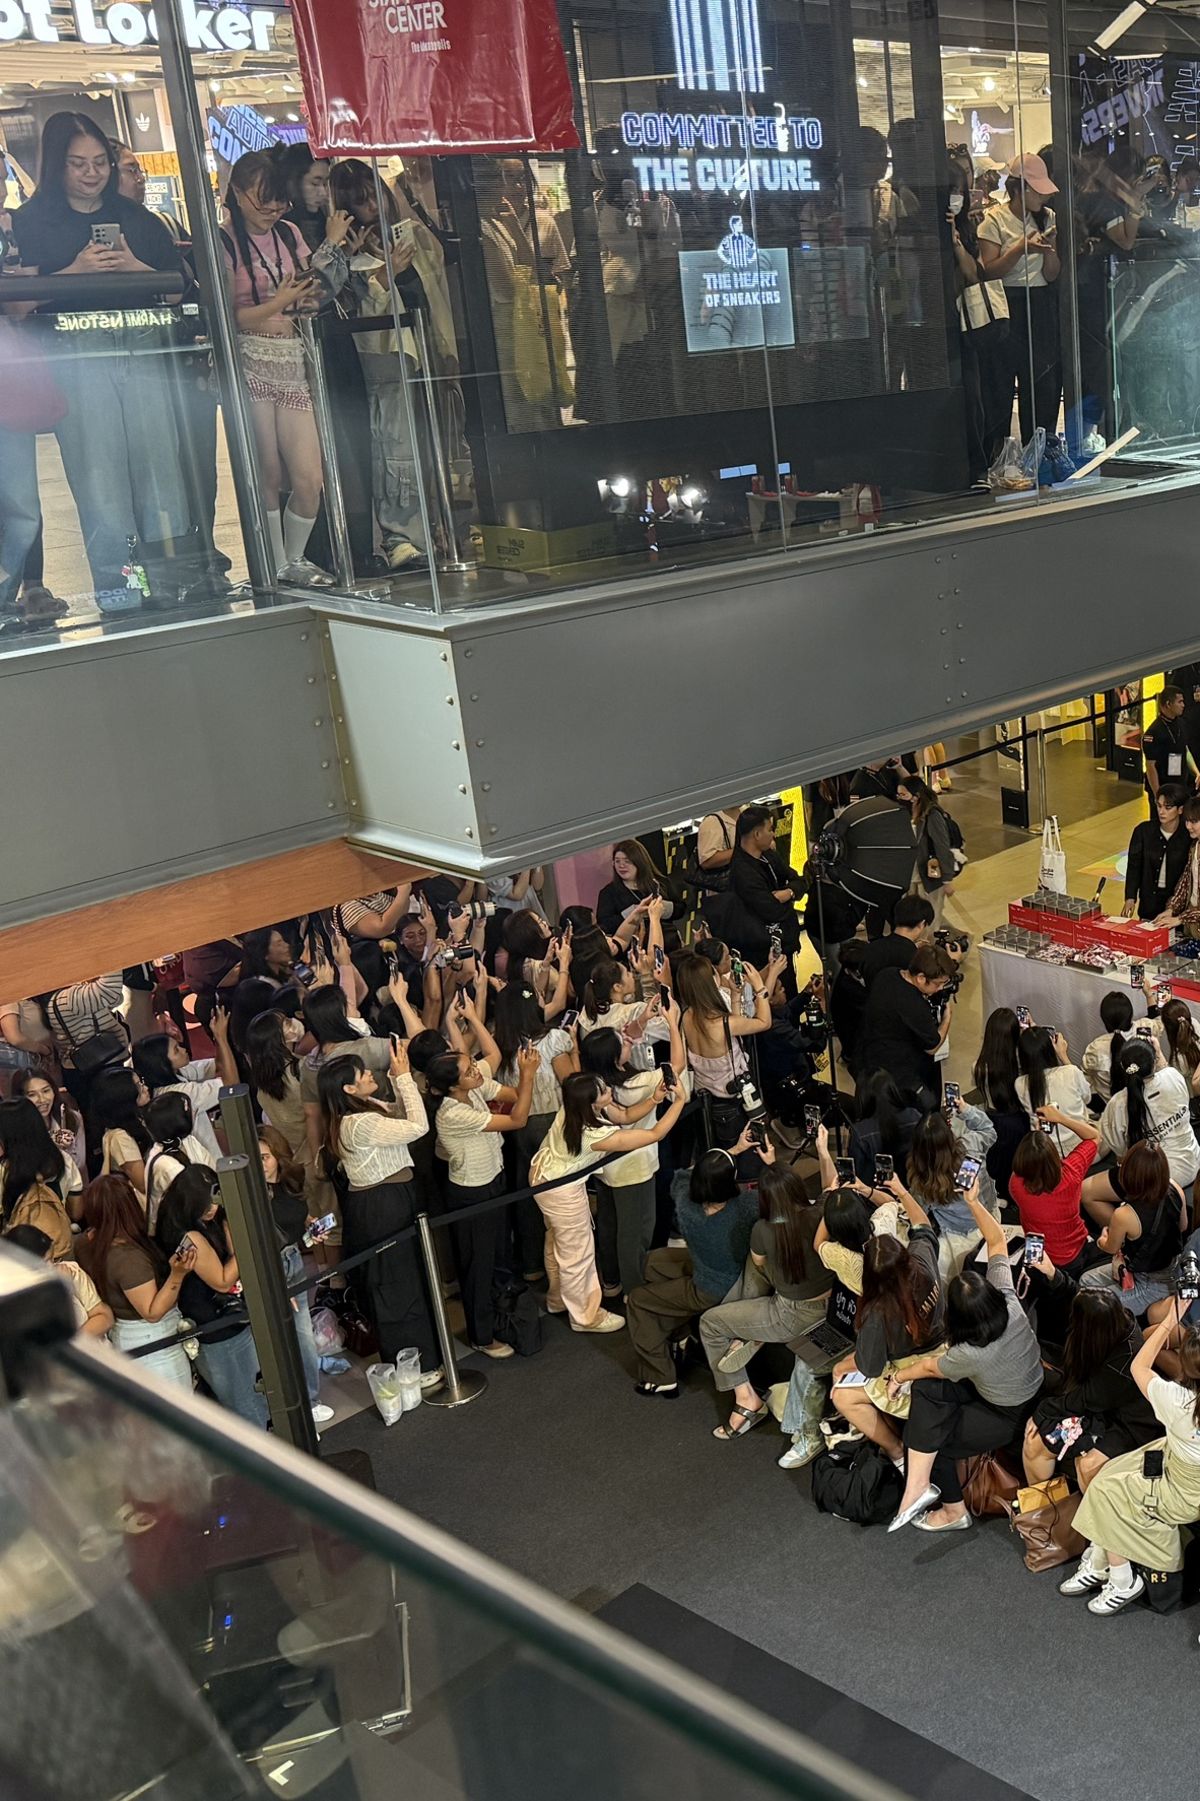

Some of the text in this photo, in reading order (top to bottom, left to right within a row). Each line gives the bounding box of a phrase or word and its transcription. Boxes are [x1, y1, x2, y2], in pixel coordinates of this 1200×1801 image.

[72, 0, 275, 51] Loker
[385, 1, 448, 34] CENTER
[621, 112, 823, 150] COMMITTED TO
[632, 157, 692, 191] THE
[702, 270, 778, 290] THE HEART
[705, 290, 781, 307] OF SNEAKERS
